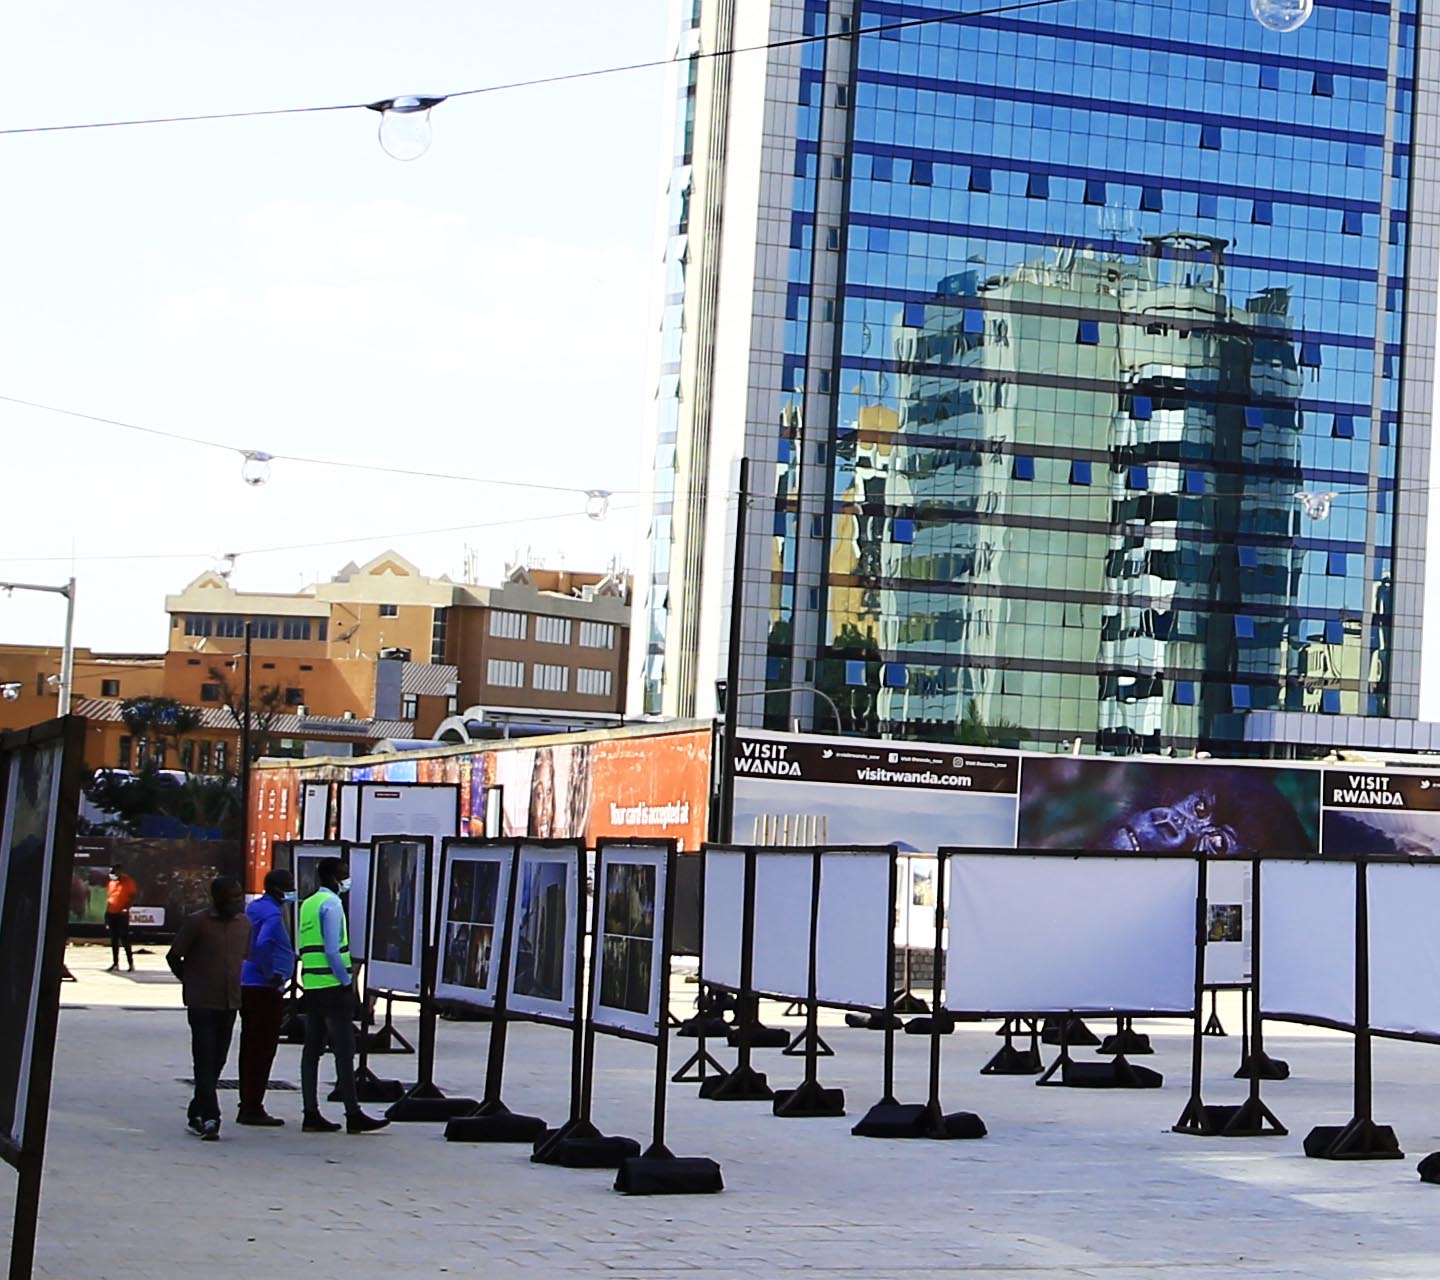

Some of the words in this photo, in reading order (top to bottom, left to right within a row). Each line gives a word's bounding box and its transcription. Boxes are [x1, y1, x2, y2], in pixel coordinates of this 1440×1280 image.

[741, 742, 788, 758] VISIT
[733, 757, 802, 776] WANDA
[856, 767, 972, 787] visitrwanda.com
[1348, 775, 1390, 790] VISIT
[1333, 790, 1404, 806] RWANDA
